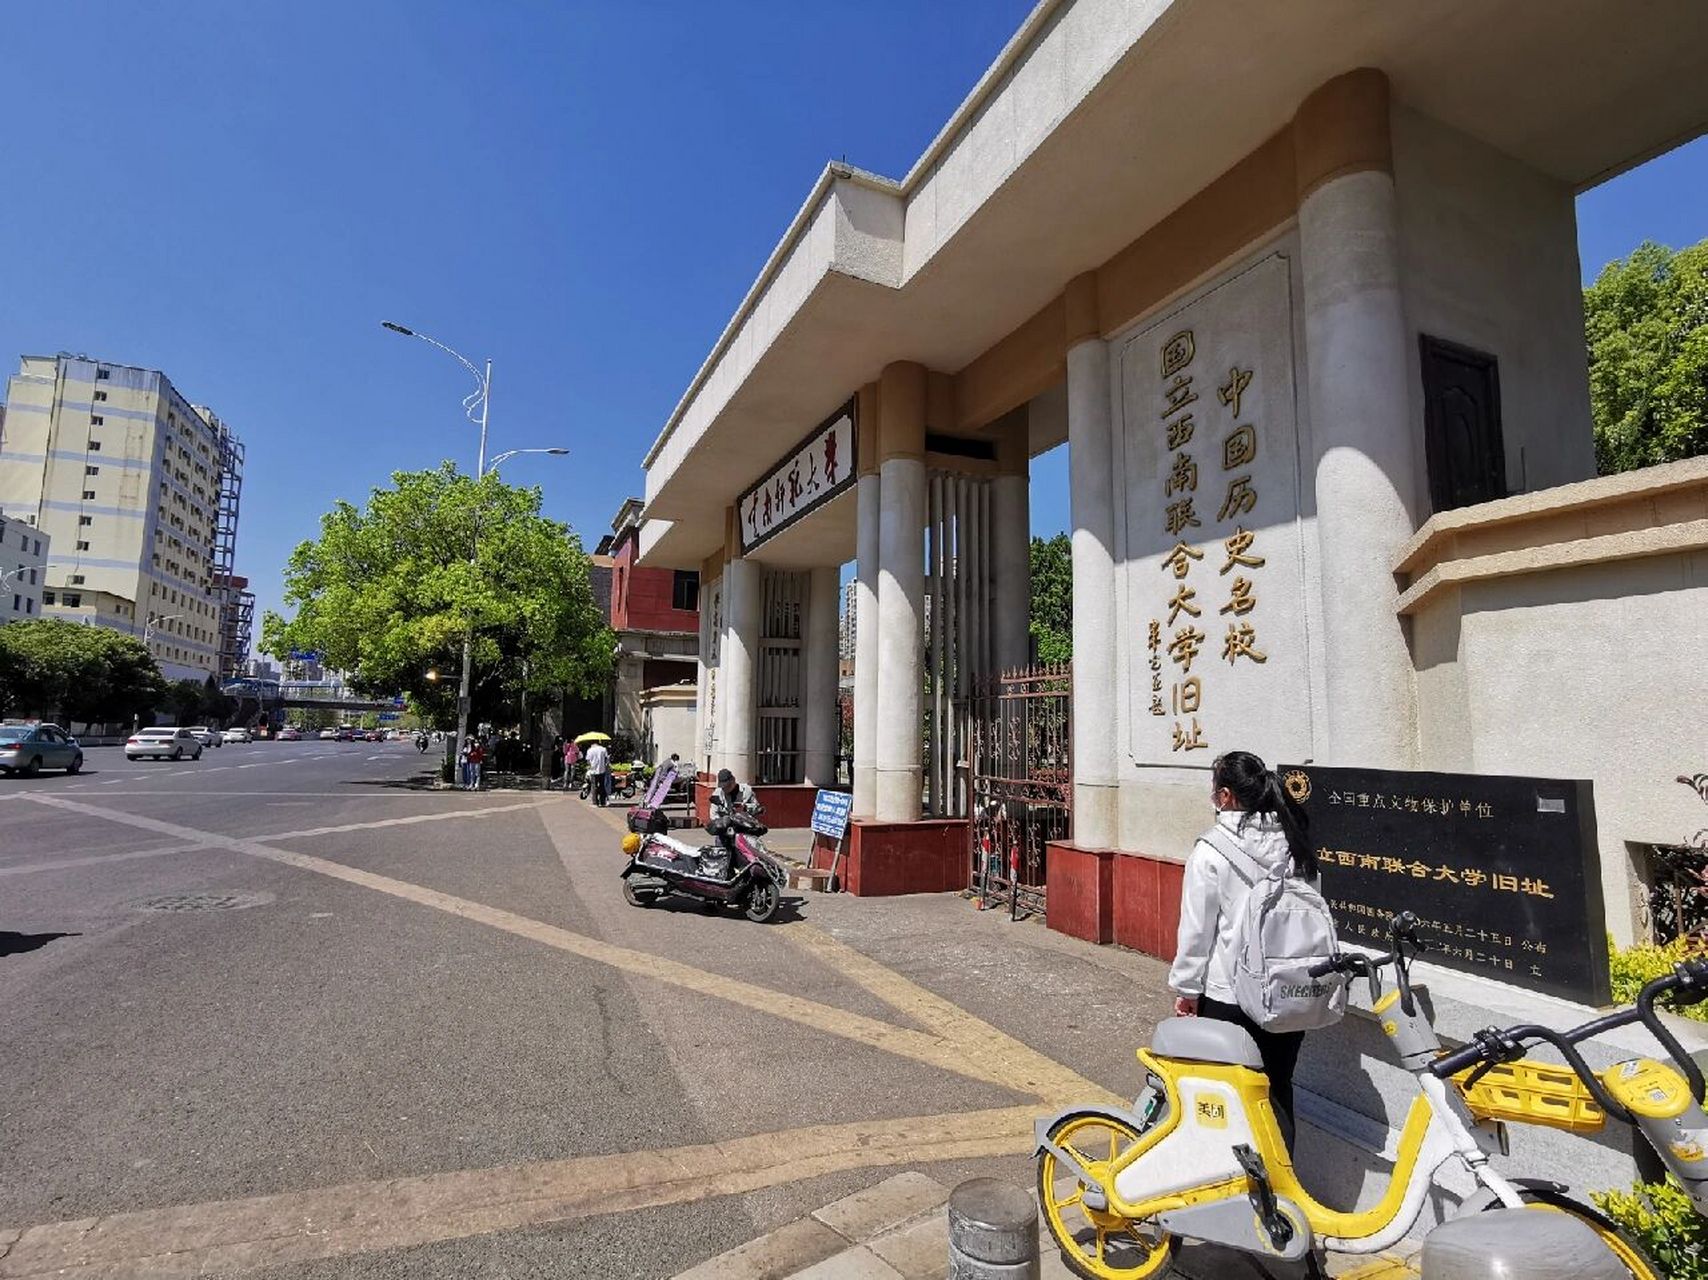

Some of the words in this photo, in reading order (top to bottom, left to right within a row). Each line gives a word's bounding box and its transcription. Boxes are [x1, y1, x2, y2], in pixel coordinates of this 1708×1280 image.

[1217, 367, 1266, 666] 中国历史名校
[1328, 790, 1495, 818] 全国重点文物保护单位
[1197, 1101, 1225, 1120] 美团
